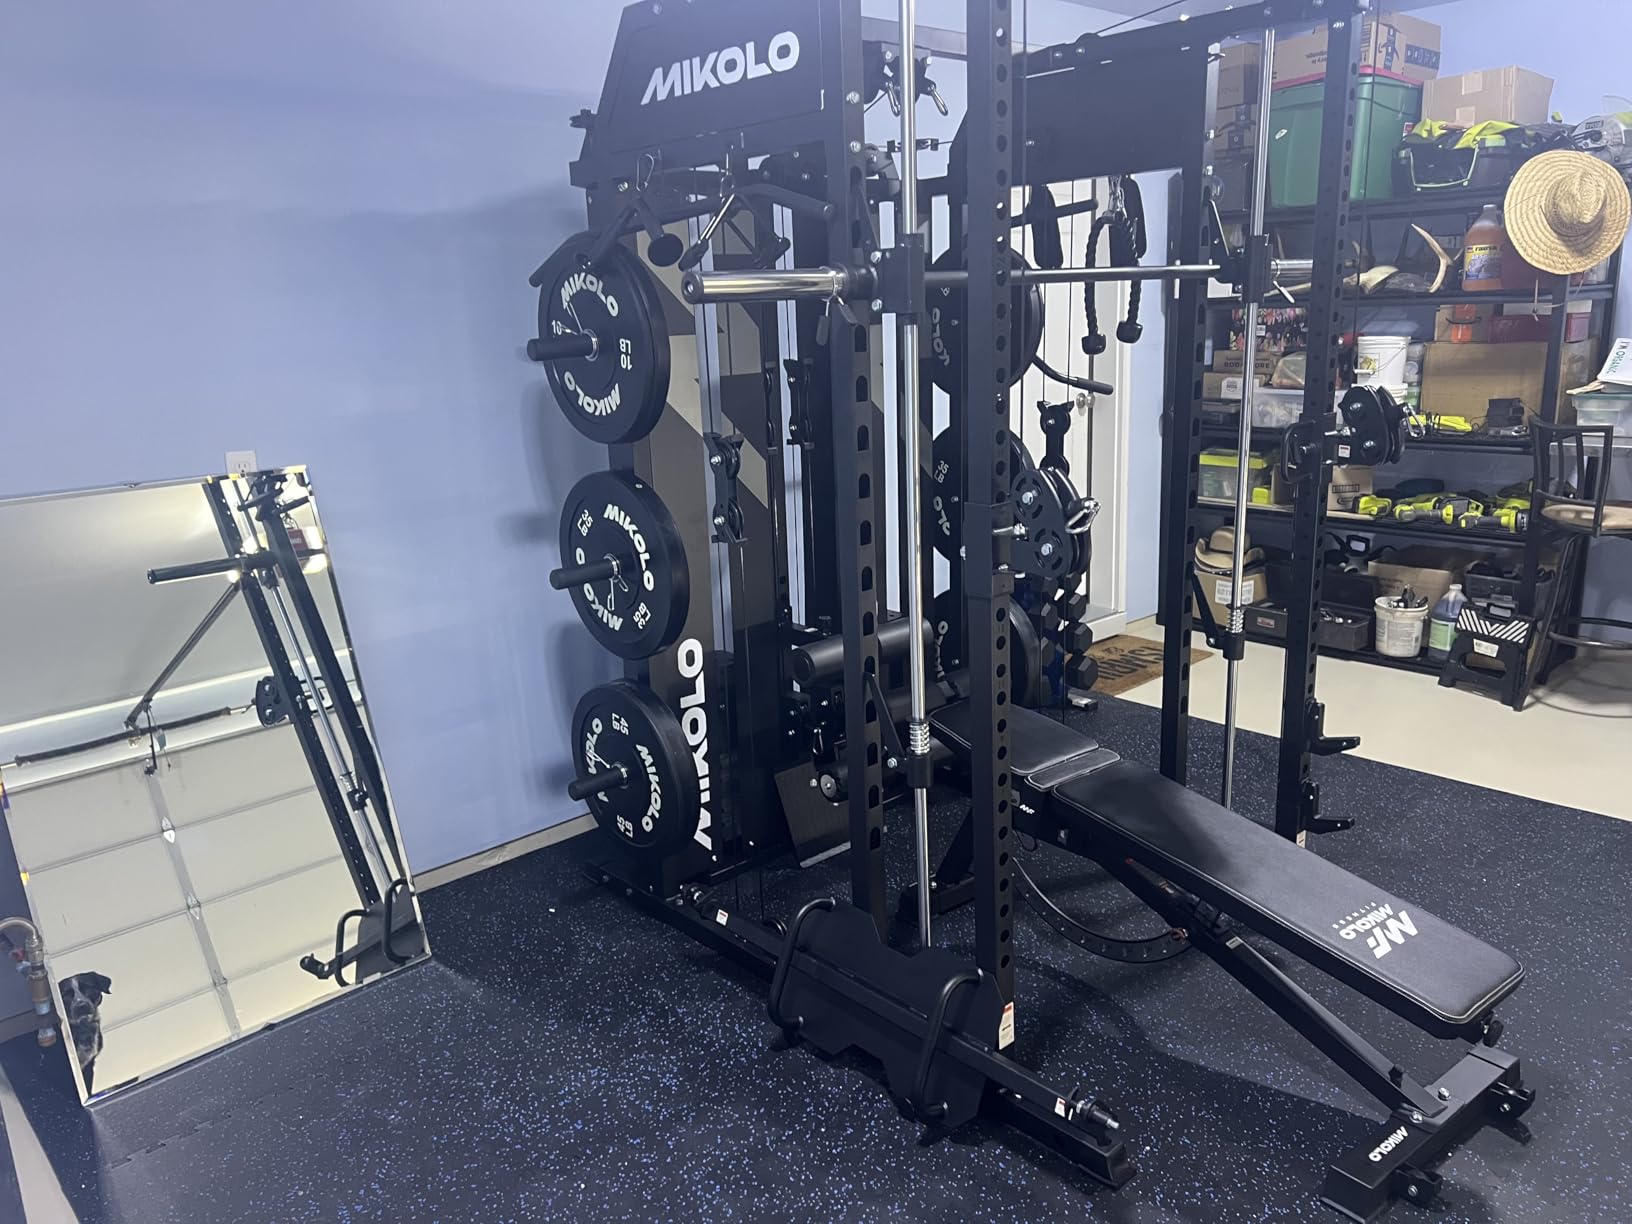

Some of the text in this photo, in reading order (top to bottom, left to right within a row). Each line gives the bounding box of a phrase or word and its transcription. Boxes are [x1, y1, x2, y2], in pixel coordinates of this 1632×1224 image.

[640, 30, 800, 105] MIKOLO
[561, 272, 619, 317] MIKOLO
[619, 338, 631, 354] LB
[932, 307, 950, 366] KOLO
[620, 354, 632, 370] 10
[564, 371, 621, 416] MIKOLO
[938, 460, 949, 474] 35
[577, 518, 588, 537] LB
[581, 509, 593, 528] 35
[603, 503, 655, 591] MIKOLO
[575, 547, 624, 631] MIKOO
[633, 610, 646, 629] 35
[639, 602, 651, 622] LB
[611, 712, 620, 731] LB
[620, 717, 629, 735] 45
[585, 718, 609, 802] KOLO
[636, 744, 662, 832] MIKOLO
[616, 814, 625, 832] 45
[624, 820, 633, 838] LB
[1339, 903, 1394, 940] MIKOLO
[1368, 1125, 1409, 1162] MIKOLO
